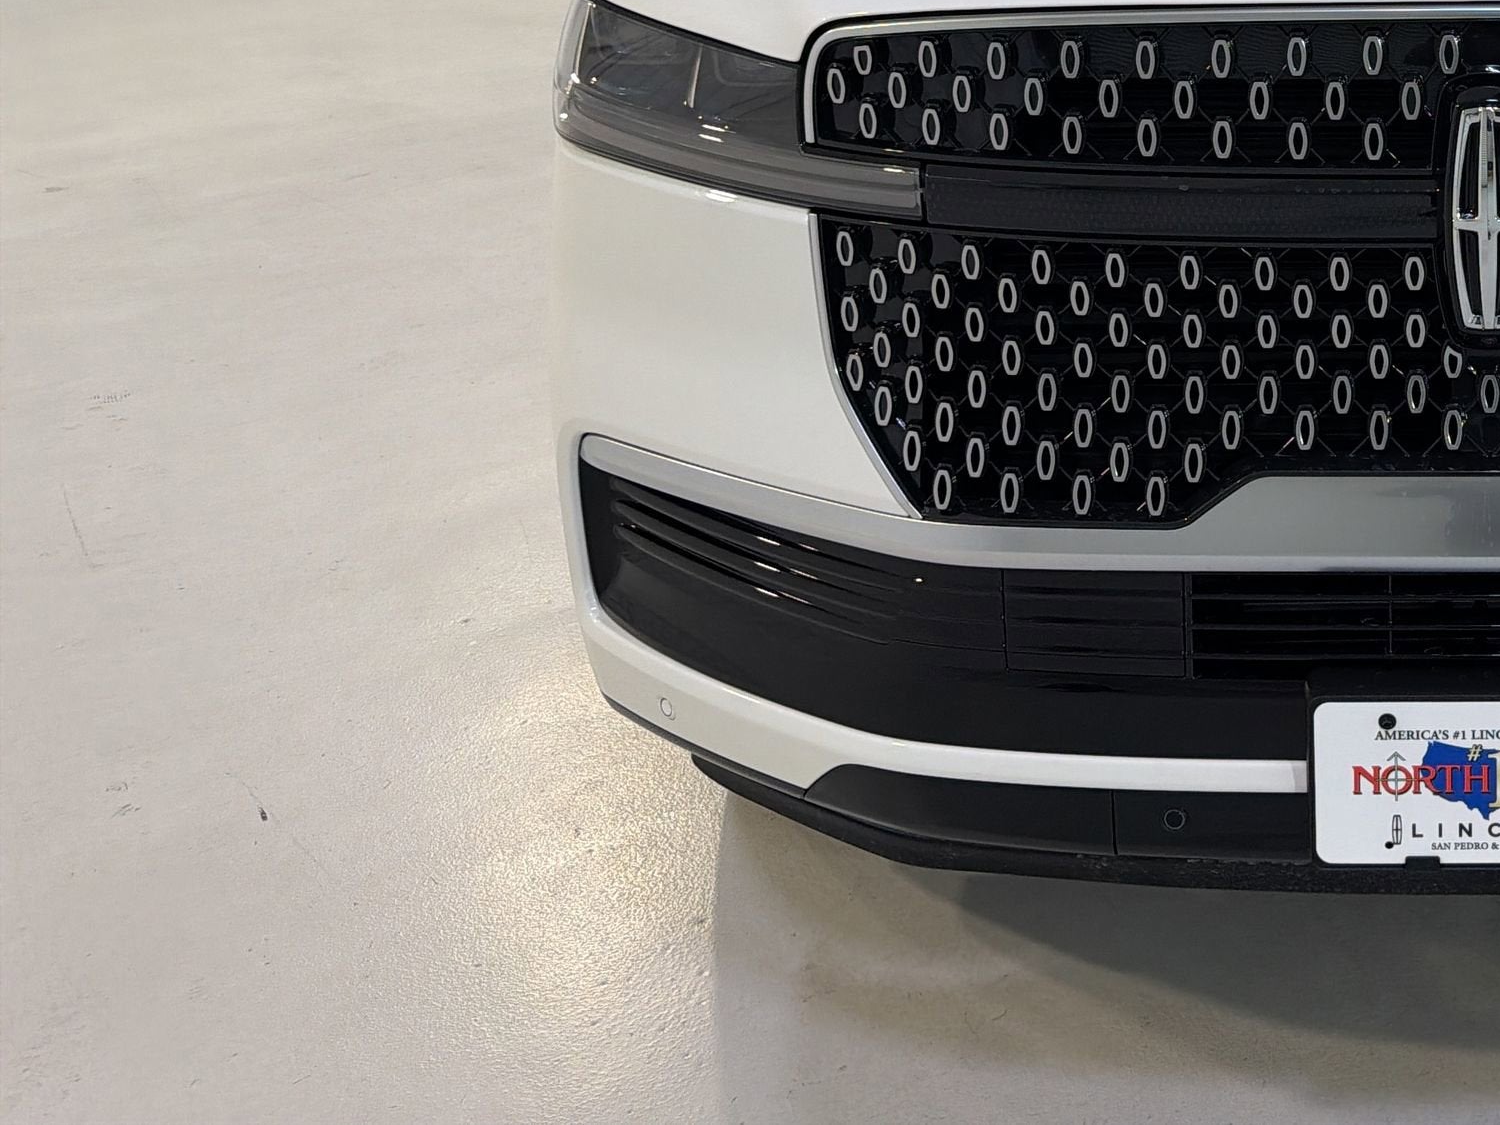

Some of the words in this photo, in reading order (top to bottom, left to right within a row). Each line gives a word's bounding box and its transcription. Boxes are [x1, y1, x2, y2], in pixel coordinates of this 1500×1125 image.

[1374, 729, 1449, 741] AMERICA'S
[1452, 729, 1467, 741] #1
[1352, 764, 1491, 796] NORTH
[1431, 842, 1451, 851] SAN
[1453, 842, 1487, 851] PEDRO
[1491, 842, 1500, 851] &
